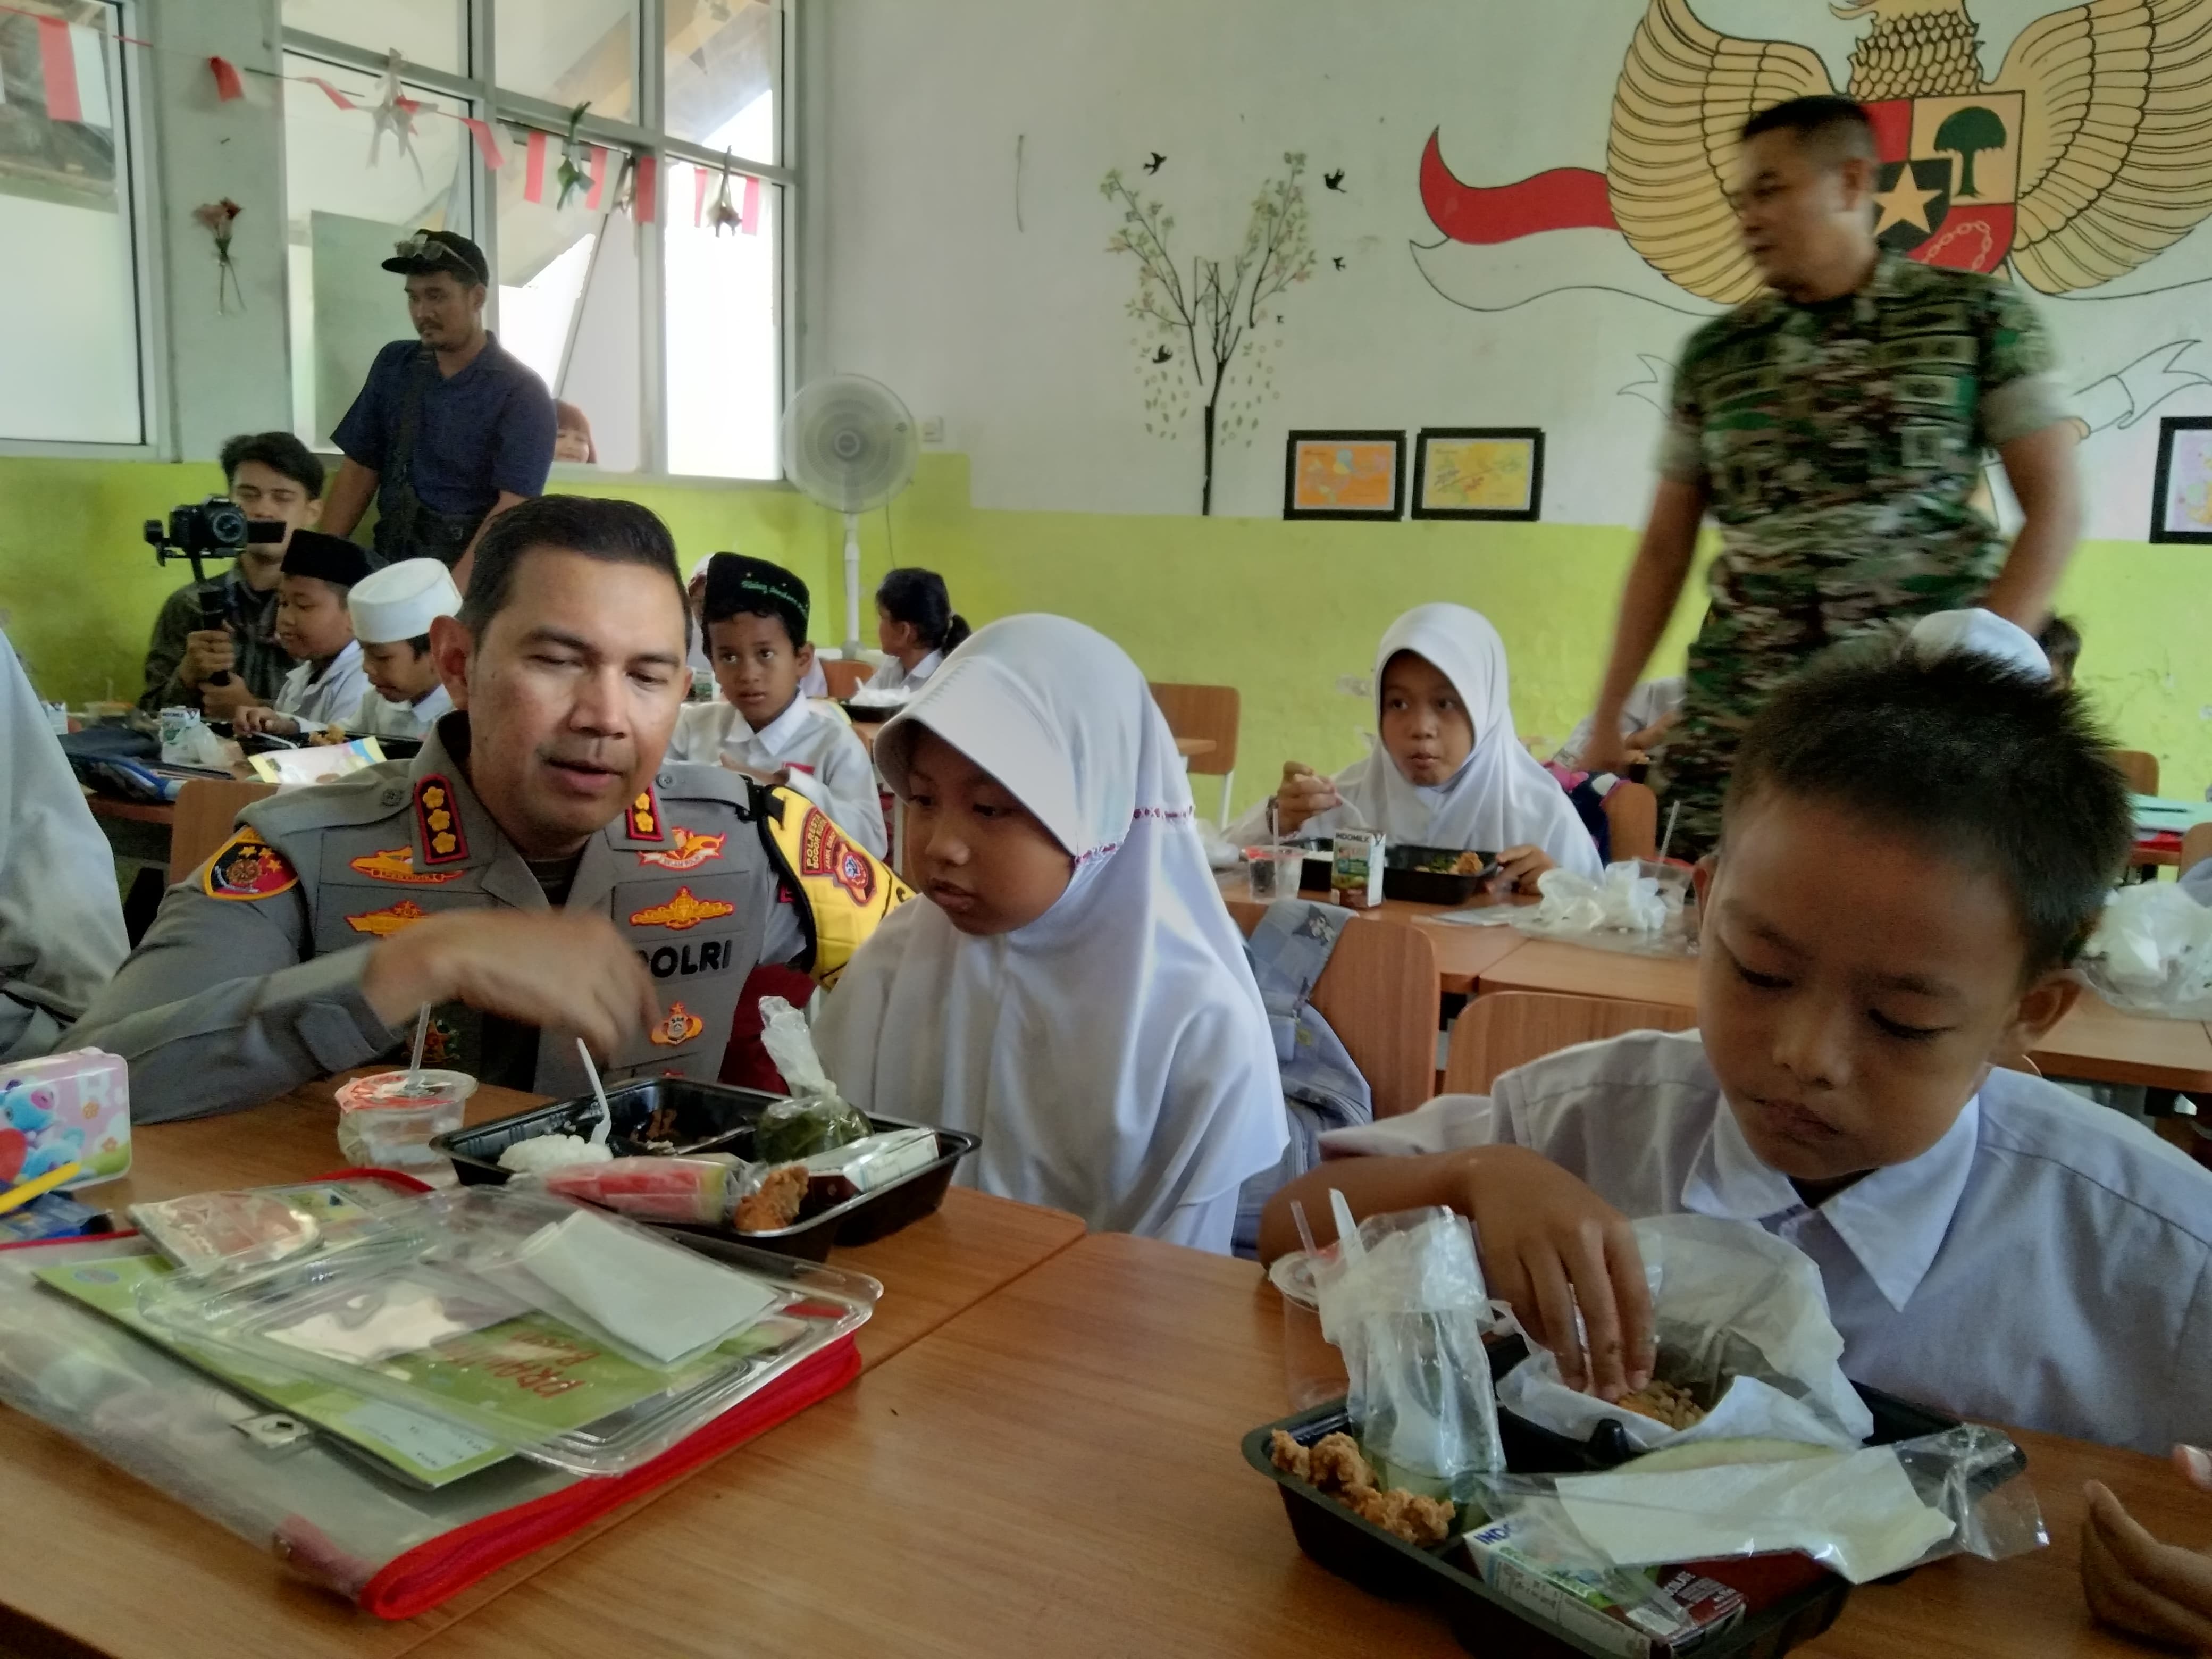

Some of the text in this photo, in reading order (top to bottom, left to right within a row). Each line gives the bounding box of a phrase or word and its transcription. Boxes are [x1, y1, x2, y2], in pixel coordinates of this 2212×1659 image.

[806, 814, 822, 867] POLRESTA
[812, 836, 821, 869] BOGOR
[637, 939, 733, 978] OLRI
